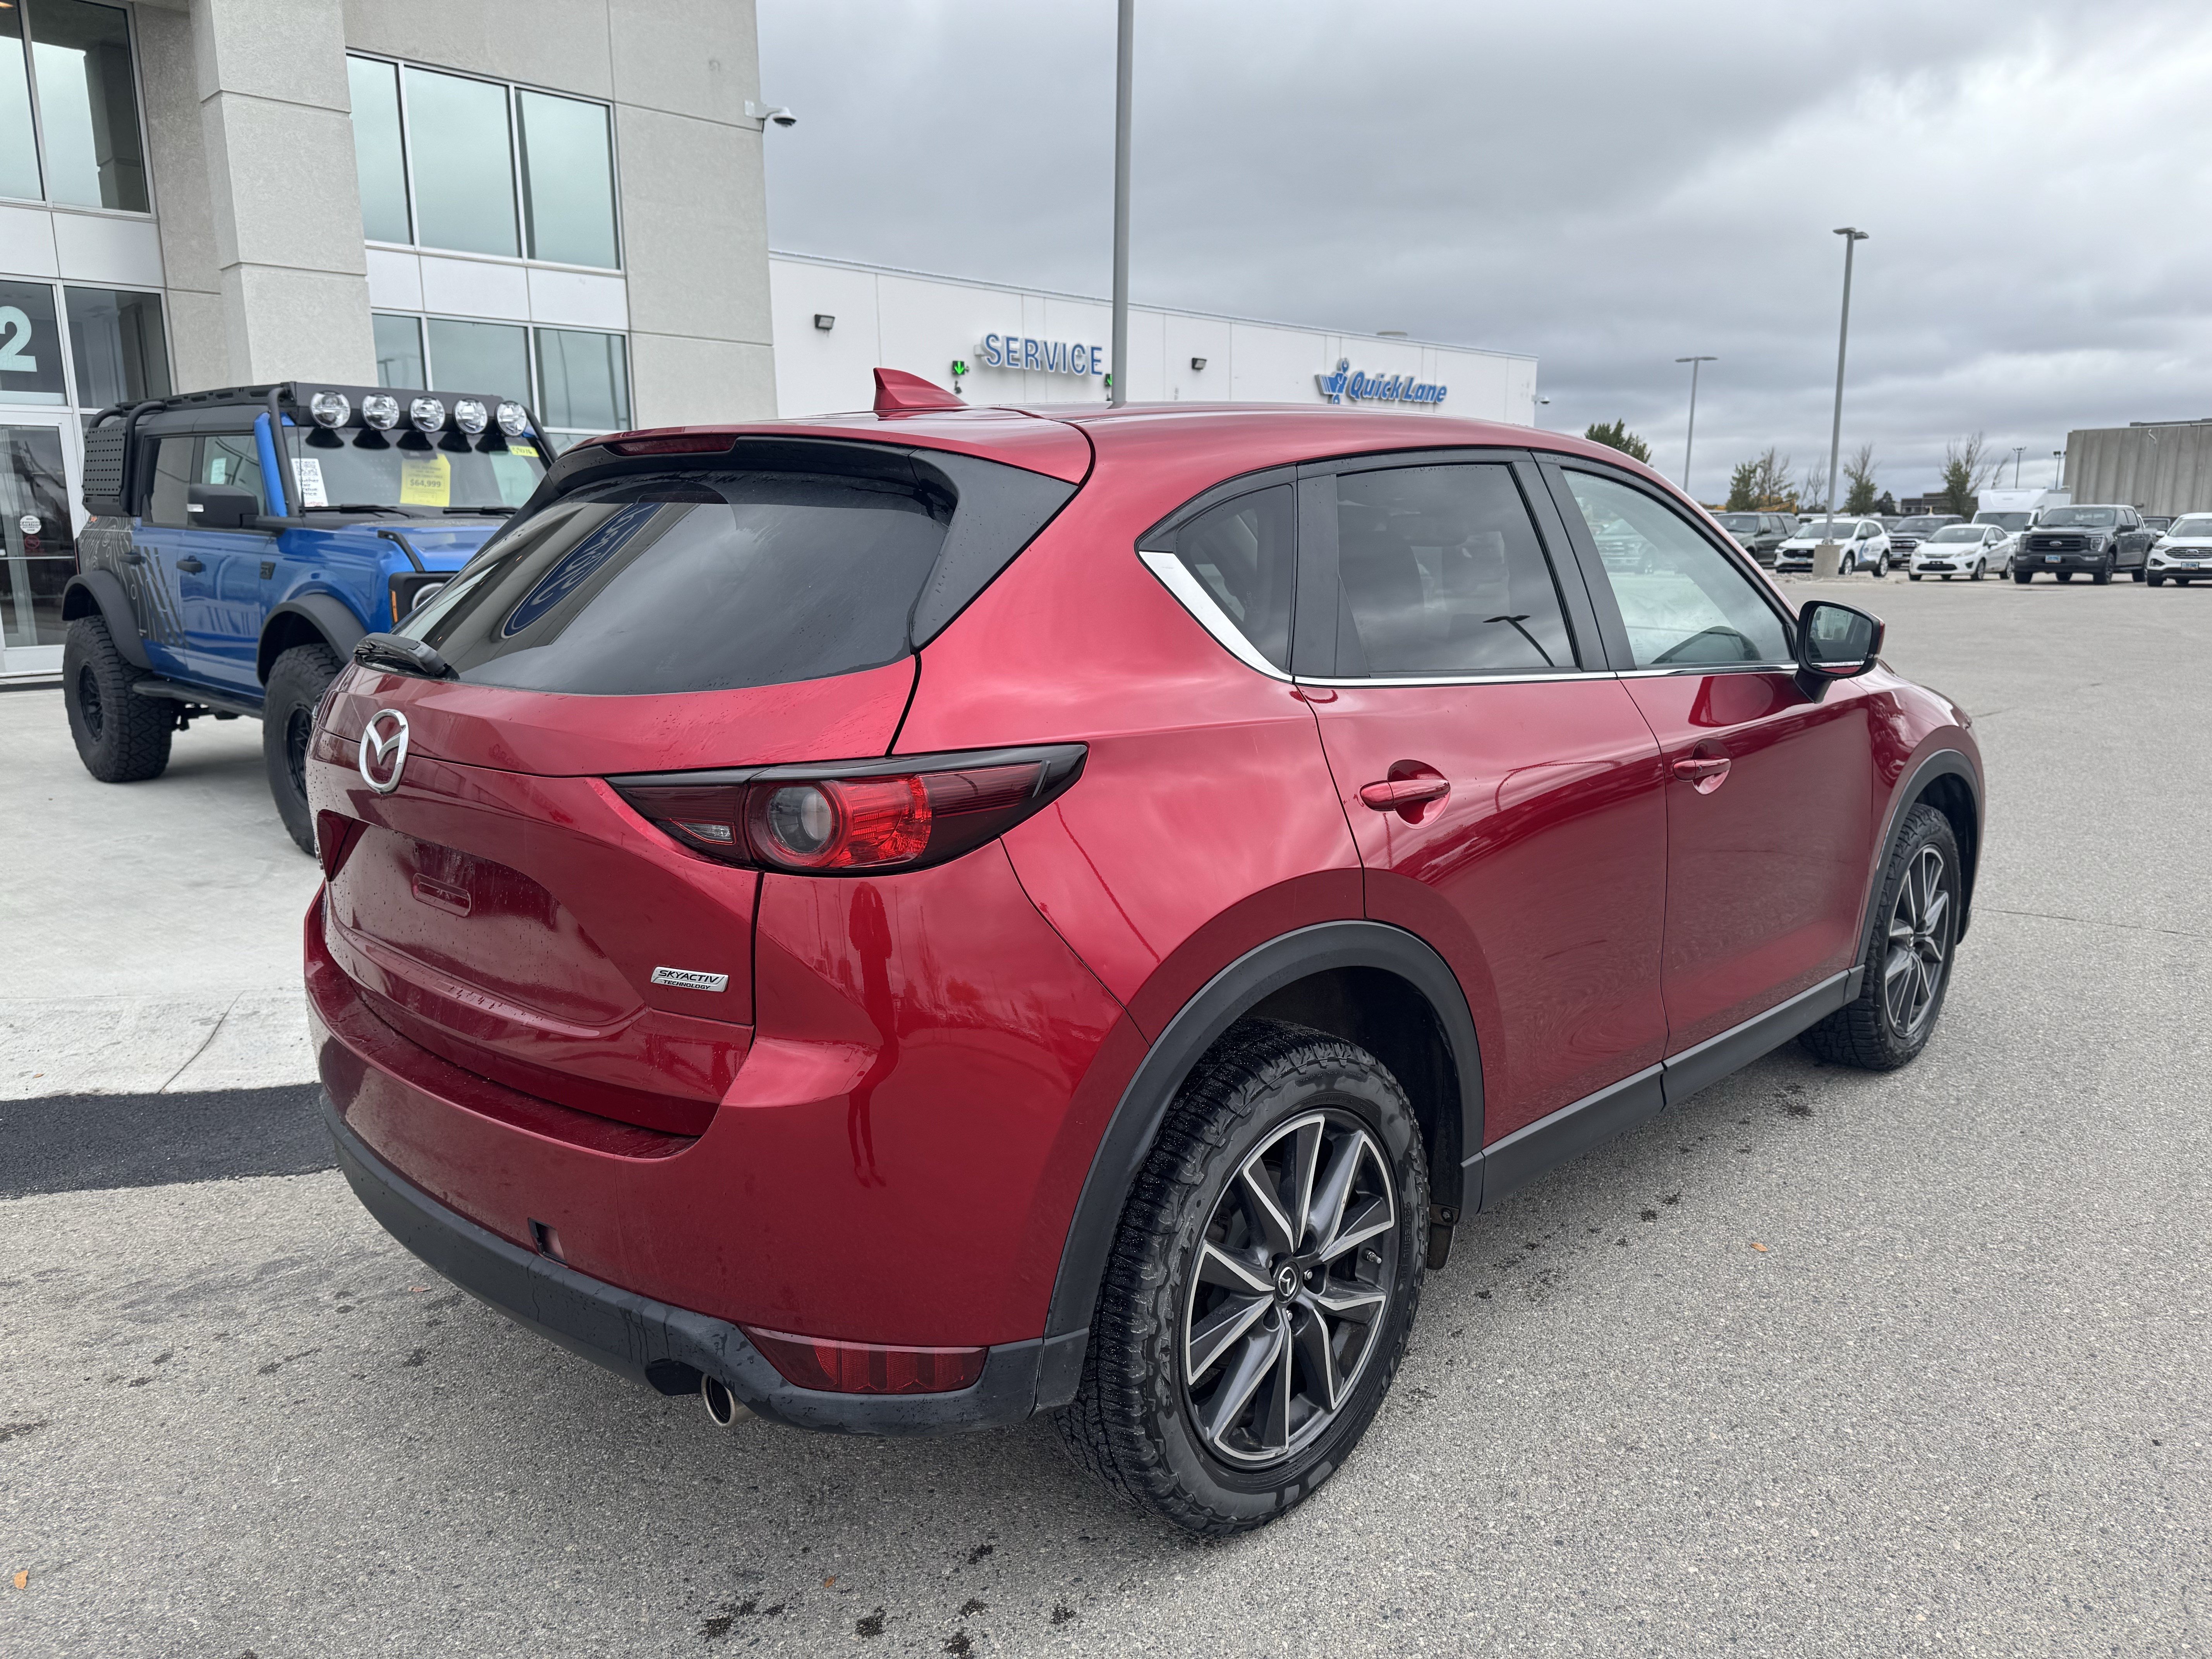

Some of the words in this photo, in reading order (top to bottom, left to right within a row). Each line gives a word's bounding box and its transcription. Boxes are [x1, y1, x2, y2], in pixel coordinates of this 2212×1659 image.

[0, 306, 37, 372] 2
[984, 333, 1103, 376] SERVICE
[1349, 371, 1402, 401] Quick
[1402, 376, 1448, 404] Lane
[410, 479, 441, 488] $64,999
[658, 970, 719, 983] SKYACTIV
[664, 980, 710, 990] TECHNOLOGY
